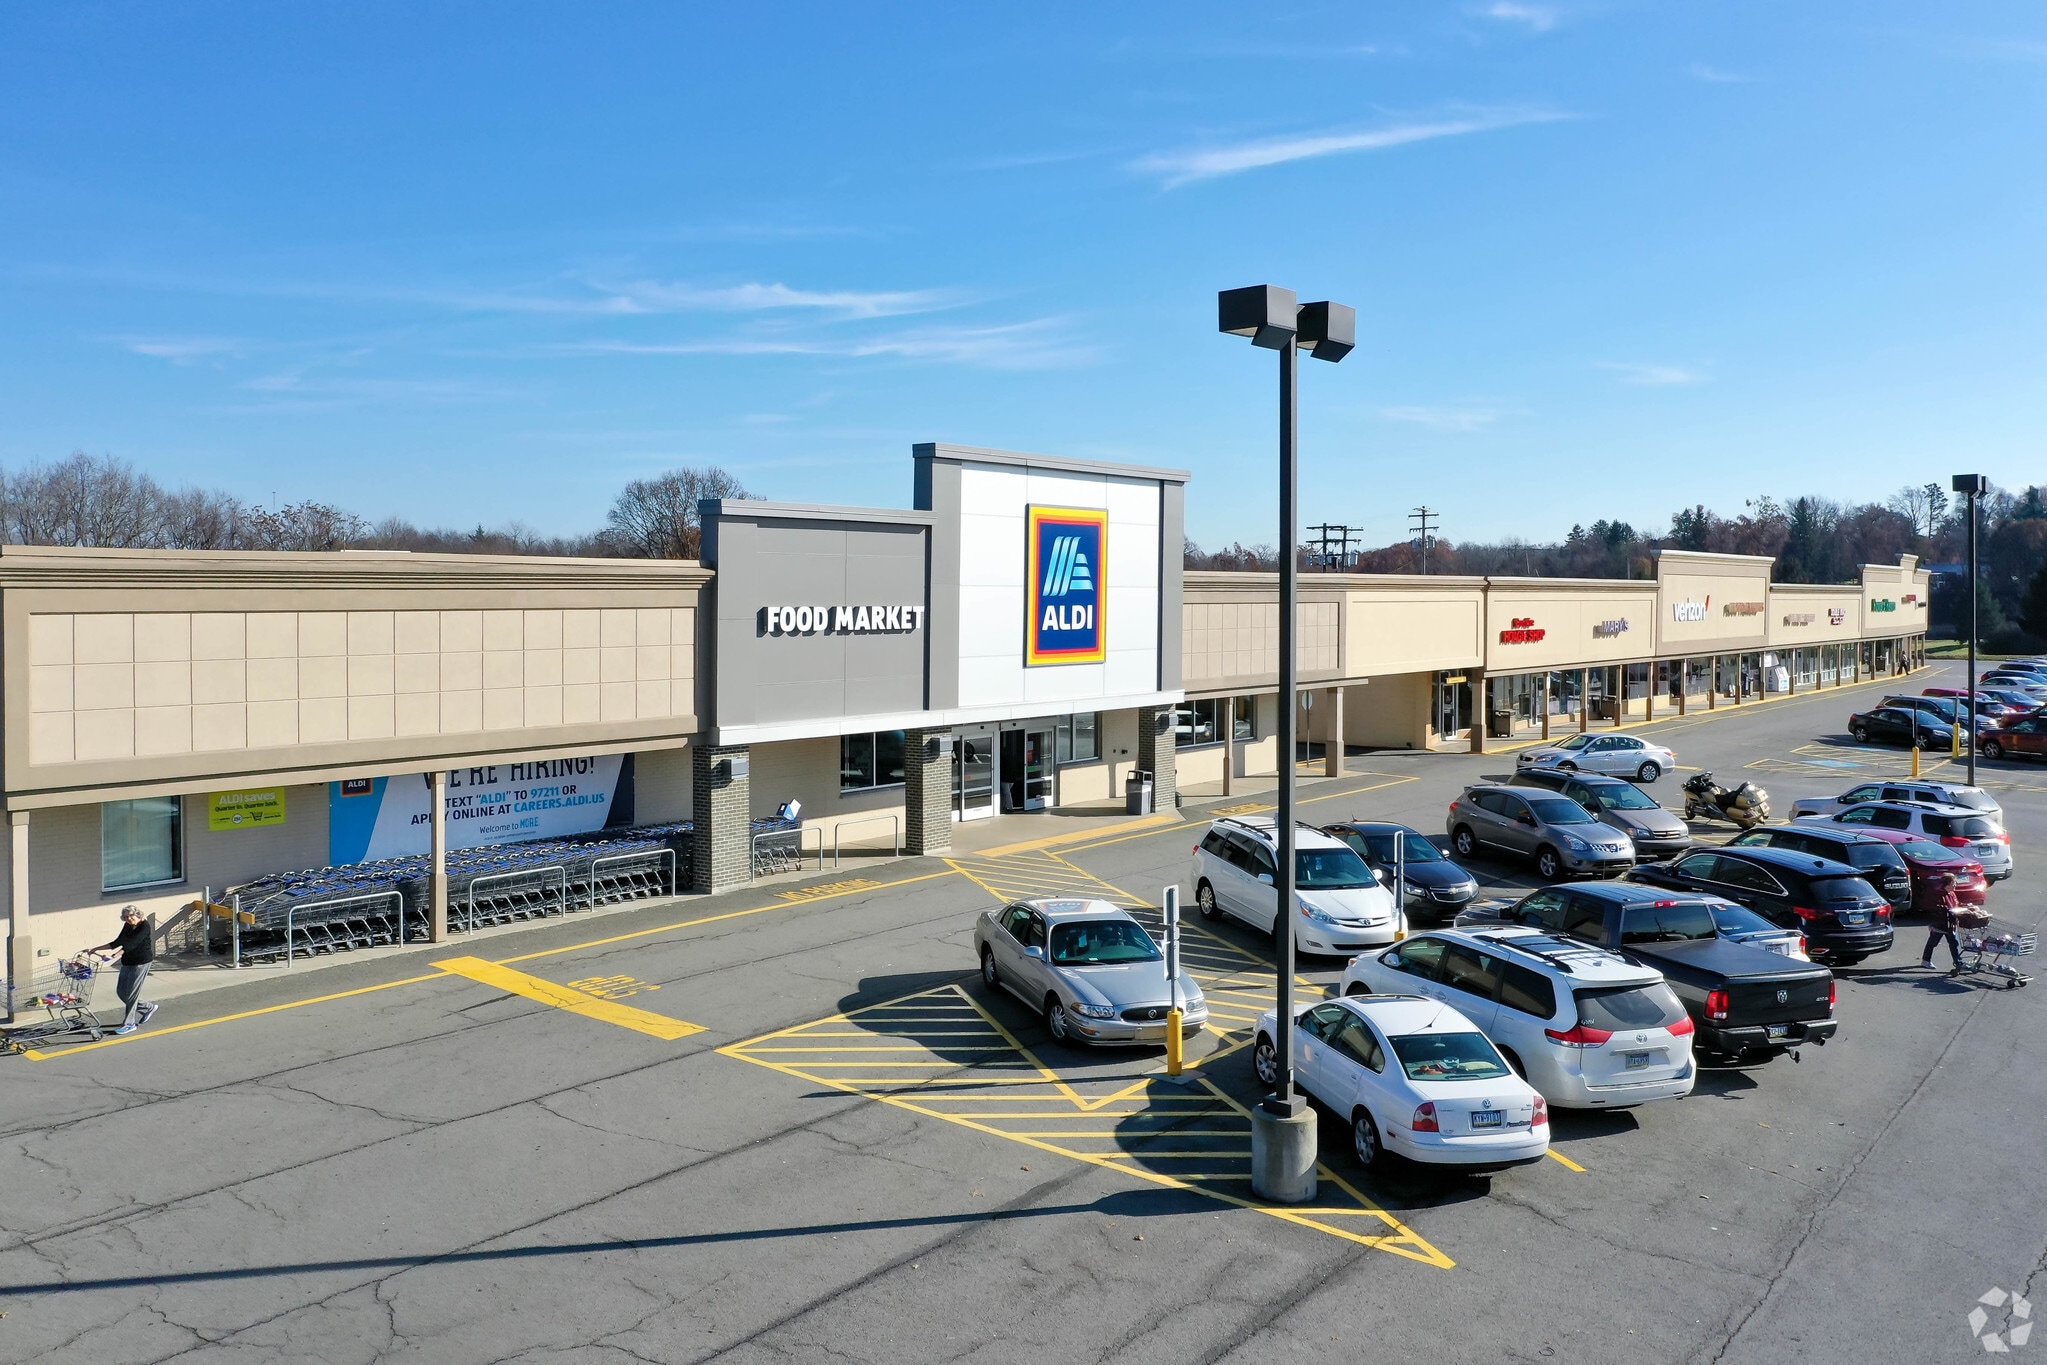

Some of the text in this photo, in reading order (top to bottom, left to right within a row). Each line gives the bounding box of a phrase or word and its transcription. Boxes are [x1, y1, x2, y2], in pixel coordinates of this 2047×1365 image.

[767, 605, 925, 632] FOOD MARKET
[1042, 604, 1093, 631] ALDI
[1674, 600, 1706, 621] verizon
[510, 756, 594, 781] HIRING!
[347, 780, 366, 788] ALDI
[219, 791, 276, 805] ALDI saves
[445, 796, 473, 808] TEXT
[514, 790, 528, 800] TO
[530, 786, 559, 799] 97211
[562, 785, 576, 795] OR
[452, 805, 495, 820] ONLINE
[497, 803, 511, 815] AT
[514, 793, 605, 813] CAREERS.ALDI.US
[480, 823, 511, 834] Welcome
[520, 816, 539, 829] MORE
